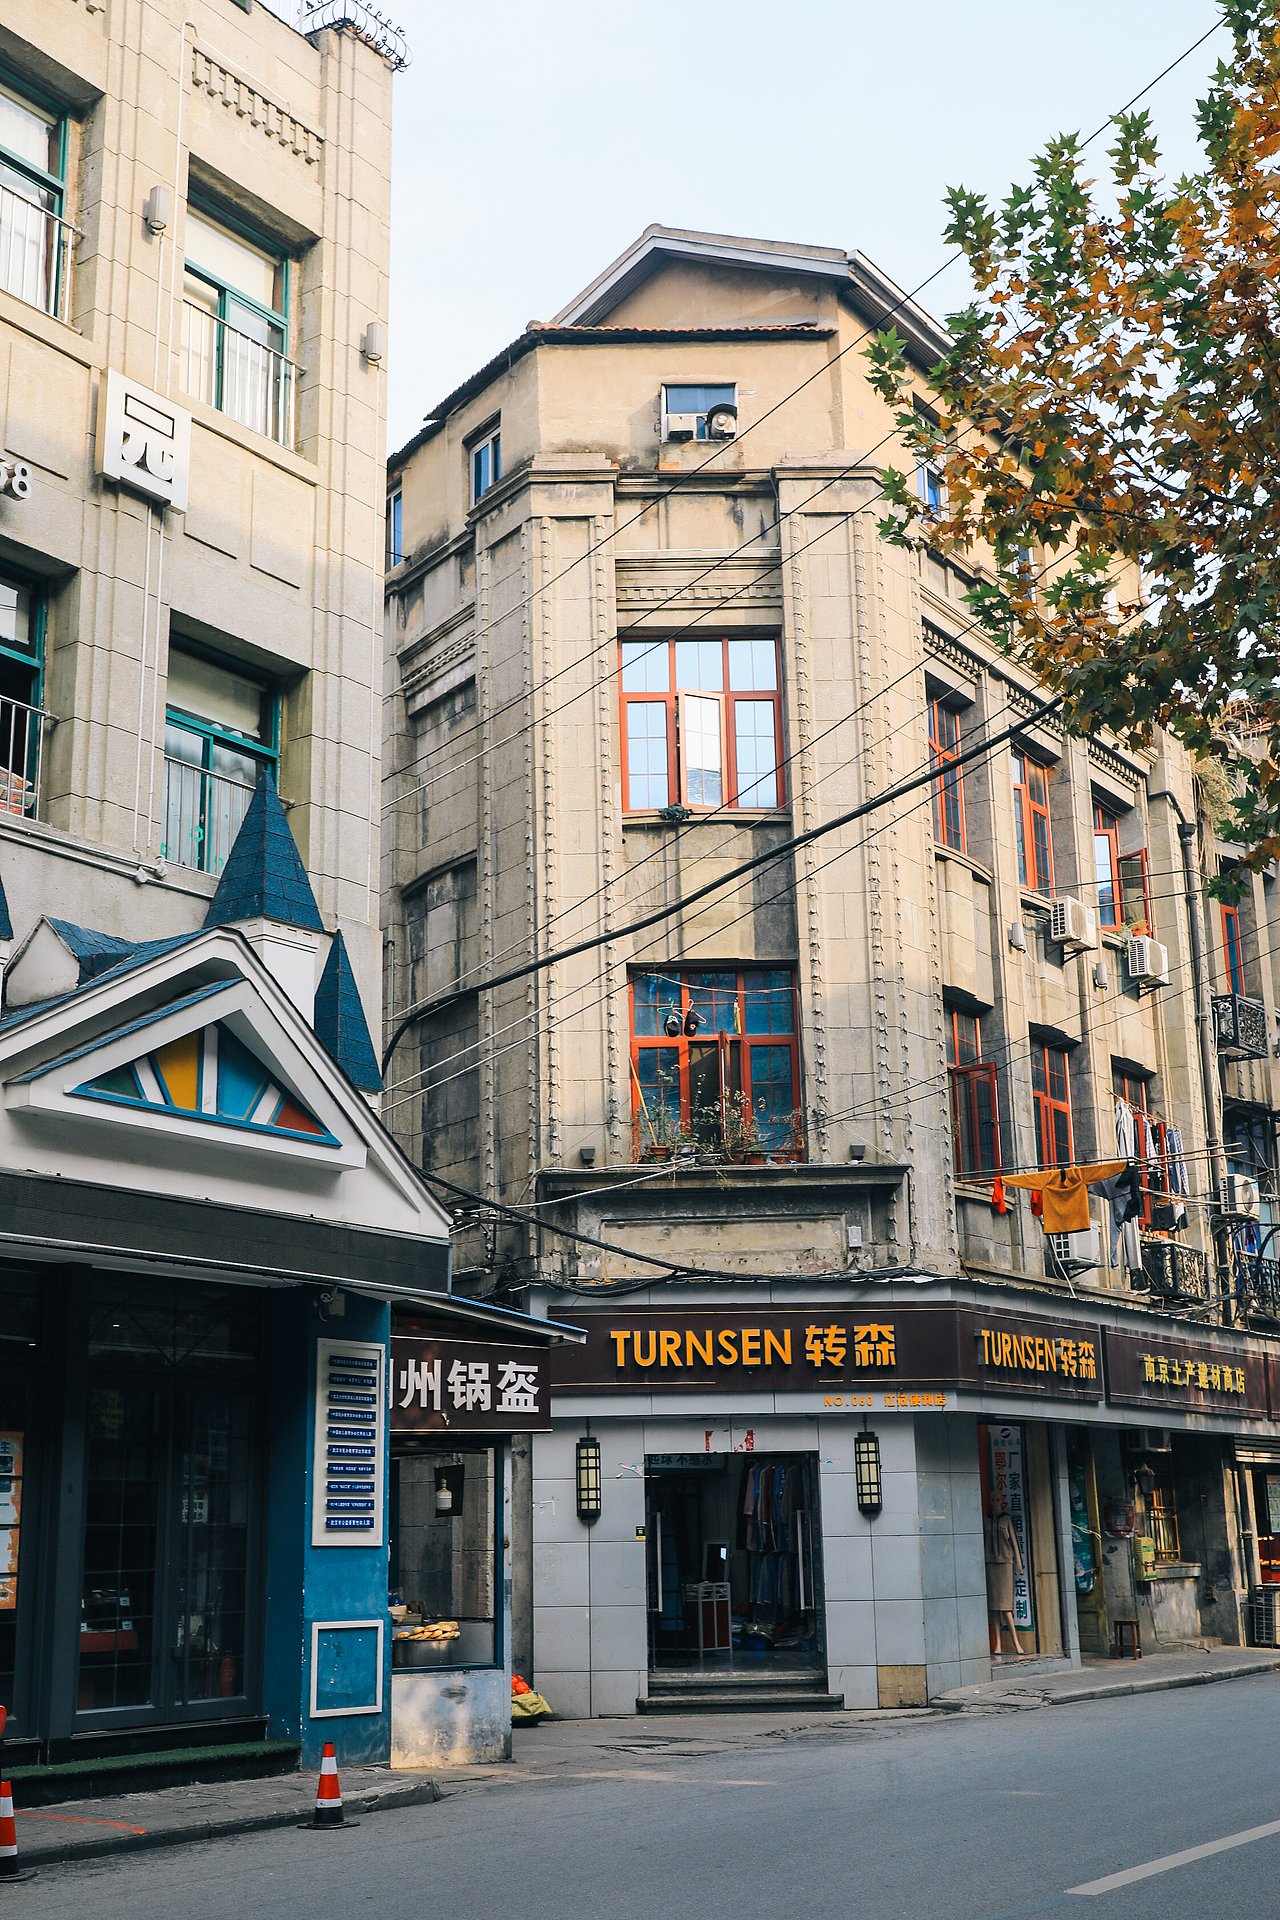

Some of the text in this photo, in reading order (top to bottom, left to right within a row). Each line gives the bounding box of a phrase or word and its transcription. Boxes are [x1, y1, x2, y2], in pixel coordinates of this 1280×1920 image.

[610, 1324, 896, 1367] TURNSEN 转森
[981, 1329, 1097, 1380] TURNSEN 转森
[389, 1358, 540, 1413] 州锅盔
[1143, 1353, 1246, 1395] 南京土产建材商店
[824, 1395, 874, 1407] NO.060
